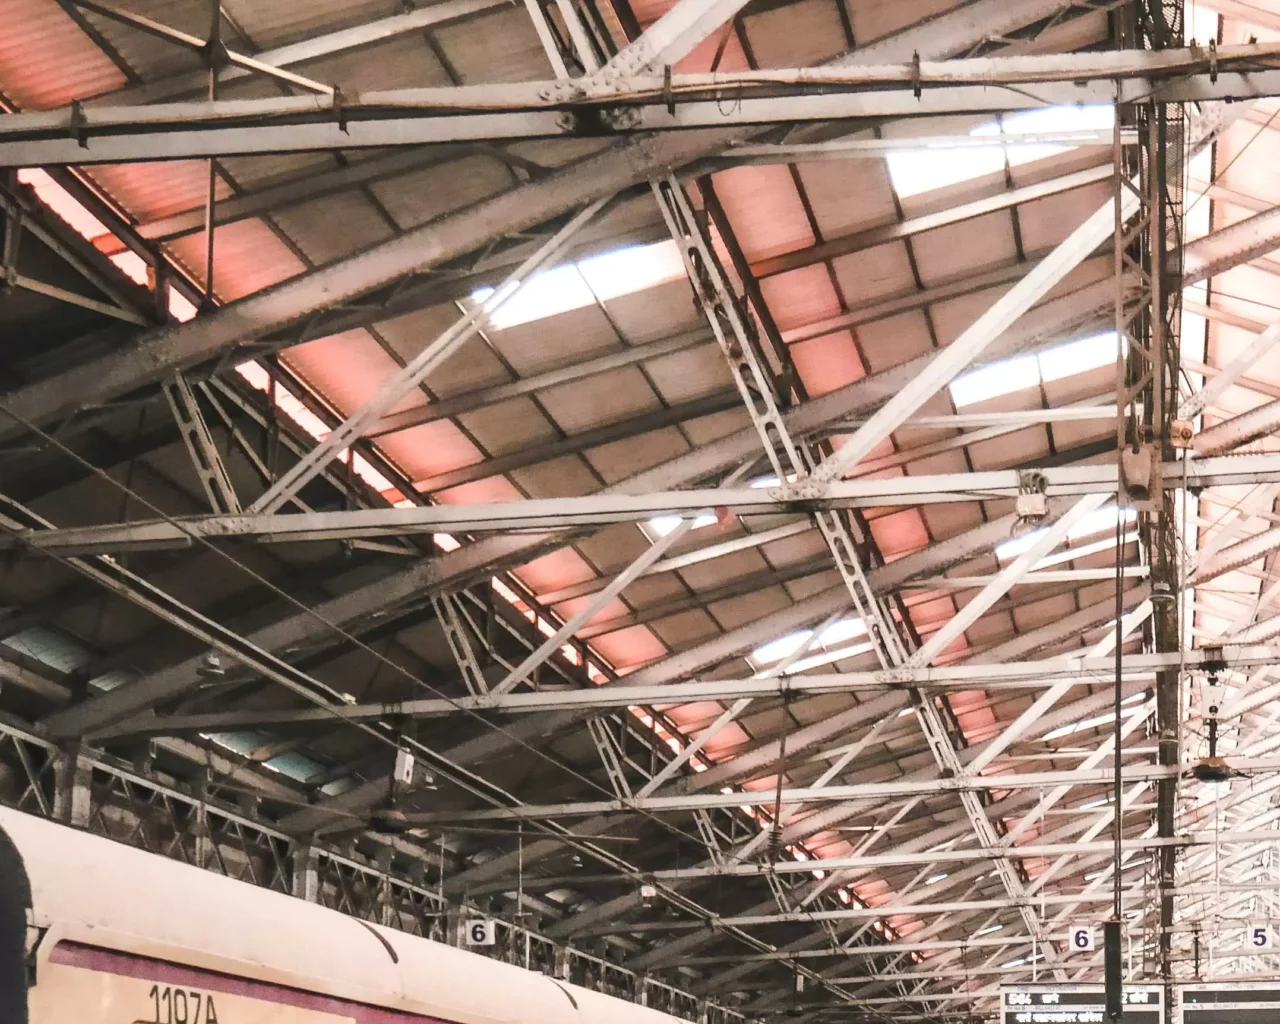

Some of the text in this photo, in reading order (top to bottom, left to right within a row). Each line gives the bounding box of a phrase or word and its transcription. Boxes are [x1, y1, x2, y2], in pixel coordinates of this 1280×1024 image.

[471, 924, 486, 942] 6
[1074, 929, 1089, 948] 6
[1252, 928, 1267, 946] 5
